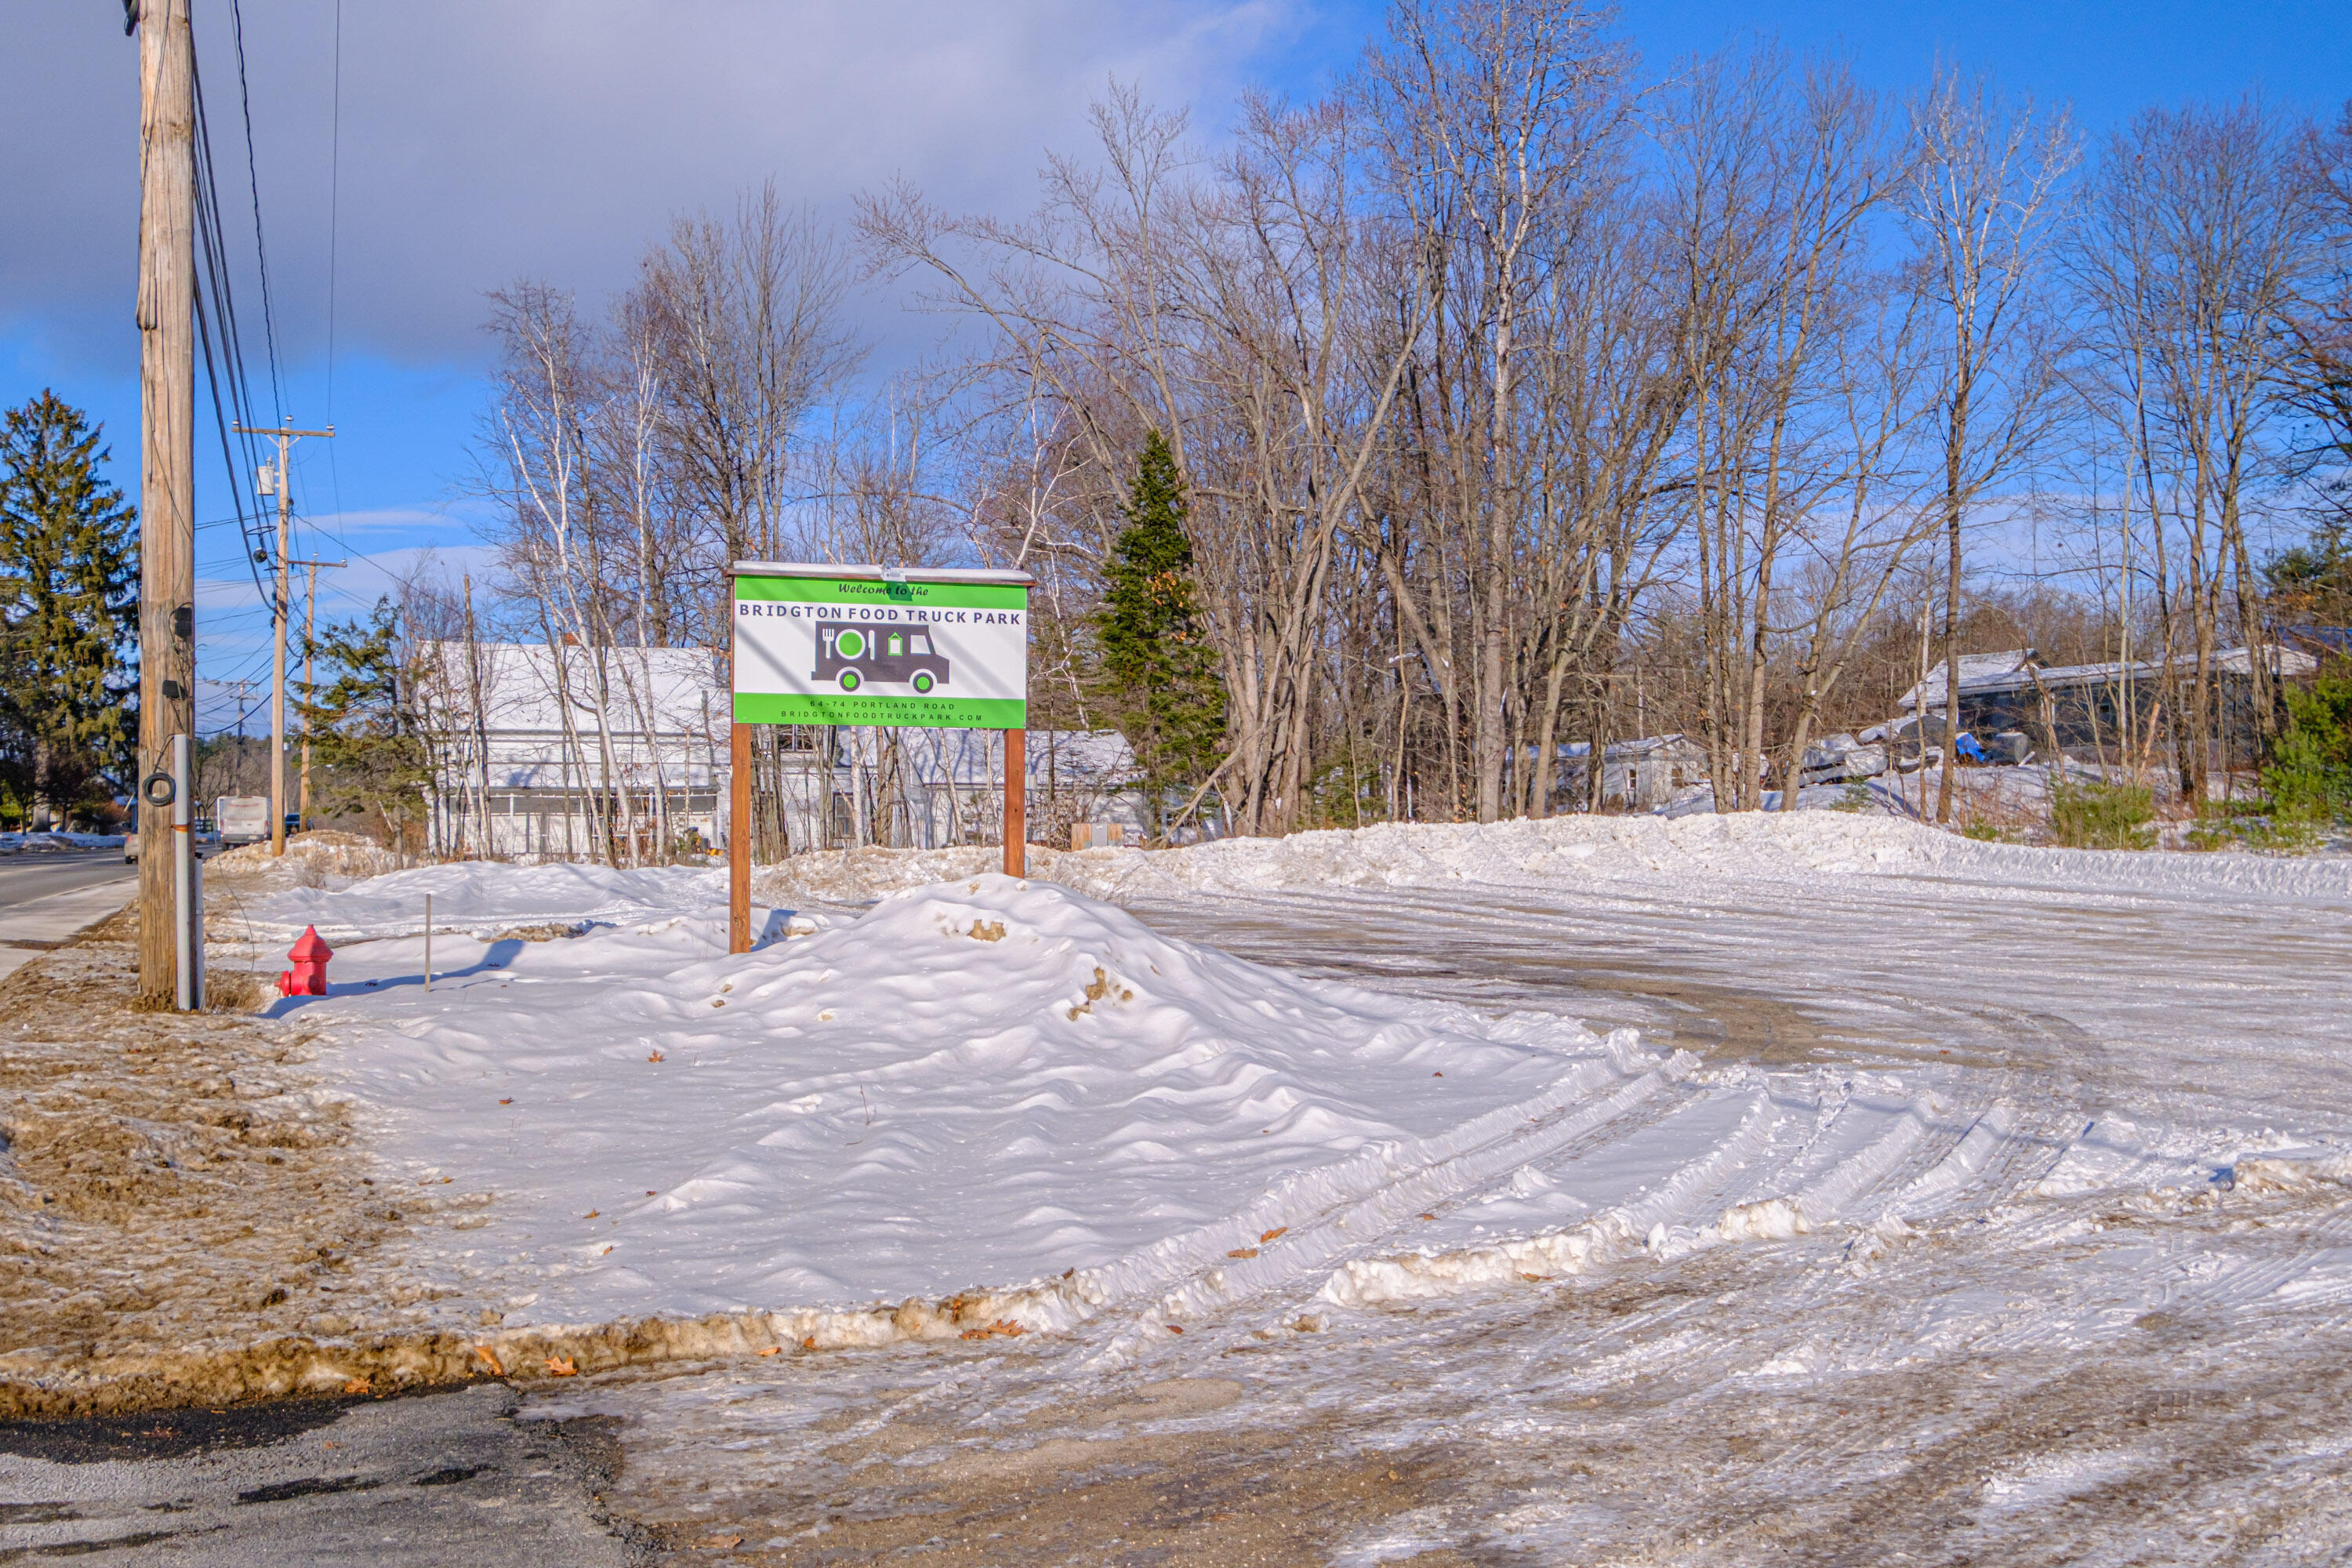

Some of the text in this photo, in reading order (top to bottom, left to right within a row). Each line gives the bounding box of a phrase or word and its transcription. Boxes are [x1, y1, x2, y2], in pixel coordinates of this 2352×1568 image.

[839, 583, 929, 596] Welcome to the
[740, 604, 1020, 625] BRIDGTON FOOD TRUCK PARK
[781, 711, 982, 721] BRIDGTONFOODTRUCKPARK.COM
